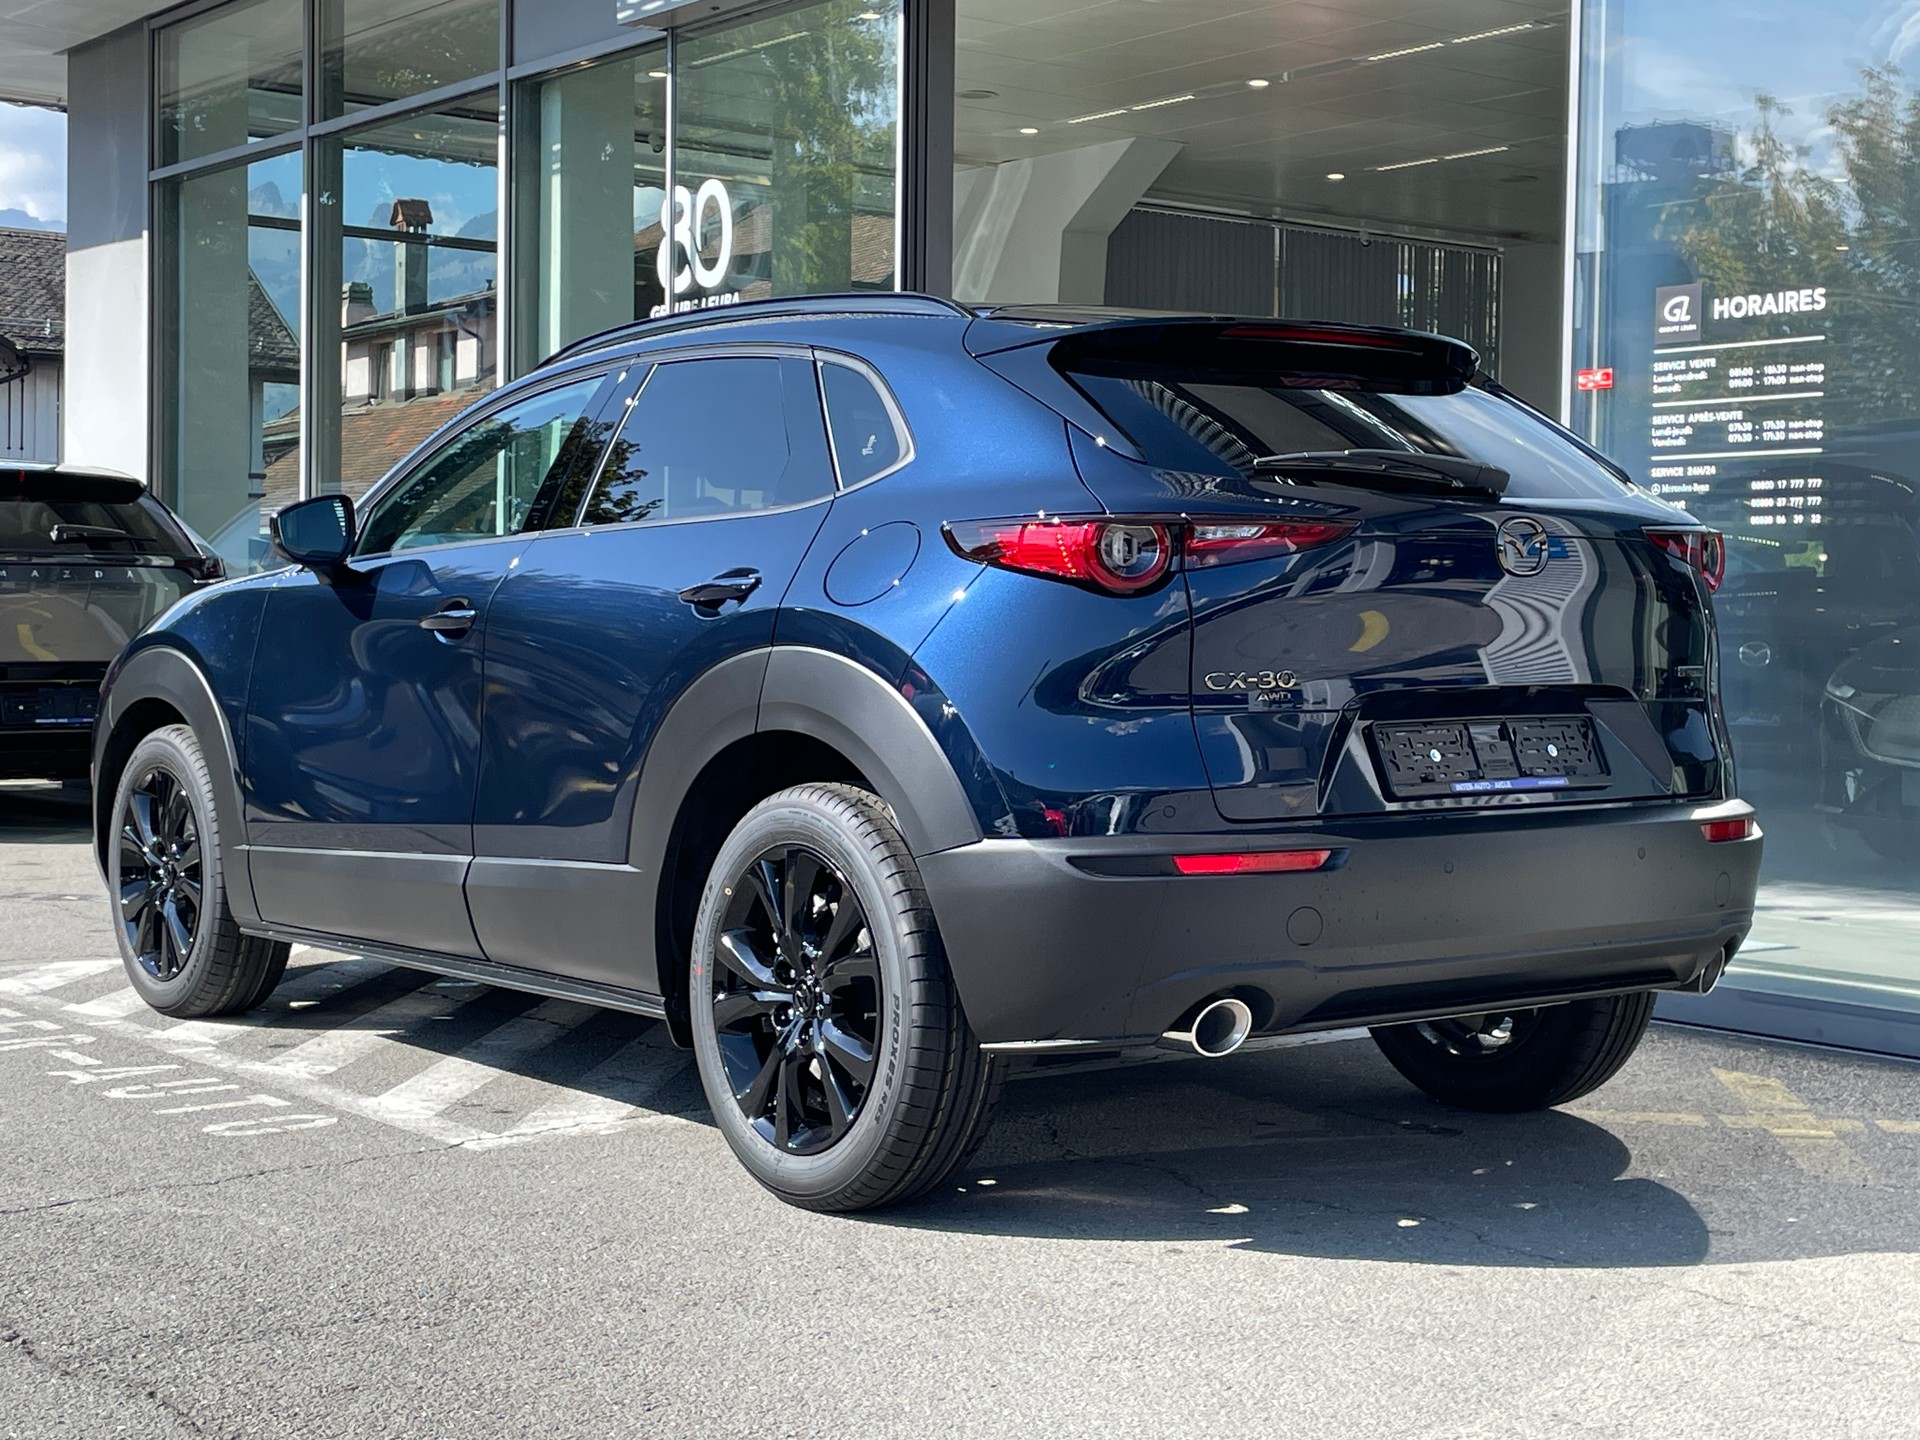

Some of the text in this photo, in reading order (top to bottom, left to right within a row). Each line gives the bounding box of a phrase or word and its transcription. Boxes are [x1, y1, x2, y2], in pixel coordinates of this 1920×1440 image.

[1713, 287, 1827, 320] HORAIRES
[1653, 357, 1717, 372] SERVICE VENTE
[1729, 367, 1753, 377] 08h00
[1763, 364, 1787, 374] 18h30
[1789, 363, 1825, 373] non-stop
[1728, 378, 1753, 388] 09h00
[1789, 374, 1824, 384] non-stop
[1652, 410, 1743, 425] SERVICE APRÈS-VENTE
[1728, 422, 1753, 432] 07h30
[1762, 420, 1786, 430] 17h30
[1788, 419, 1823, 429] non-stop
[1728, 433, 1752, 443] 07h30
[1762, 431, 1785, 441] 17h30
[1788, 430, 1823, 440] non-stop
[1651, 467, 1684, 478] SERVICE
[1661, 482, 1710, 493] Mercedes-Benz
[1777, 479, 1787, 489] 17
[1790, 478, 1804, 488] 777
[1807, 478, 1823, 488] 777
[1790, 496, 1804, 507] 777
[1807, 496, 1822, 506] 777
[0, 569, 134, 579] MAZDA
[1204, 670, 1297, 692] CX-30
[1257, 691, 1292, 702] AWD
[1474, 781, 1491, 790] AUTO
[1495, 780, 1513, 789] AIGLE
[885, 992, 901, 1091] PROXES
